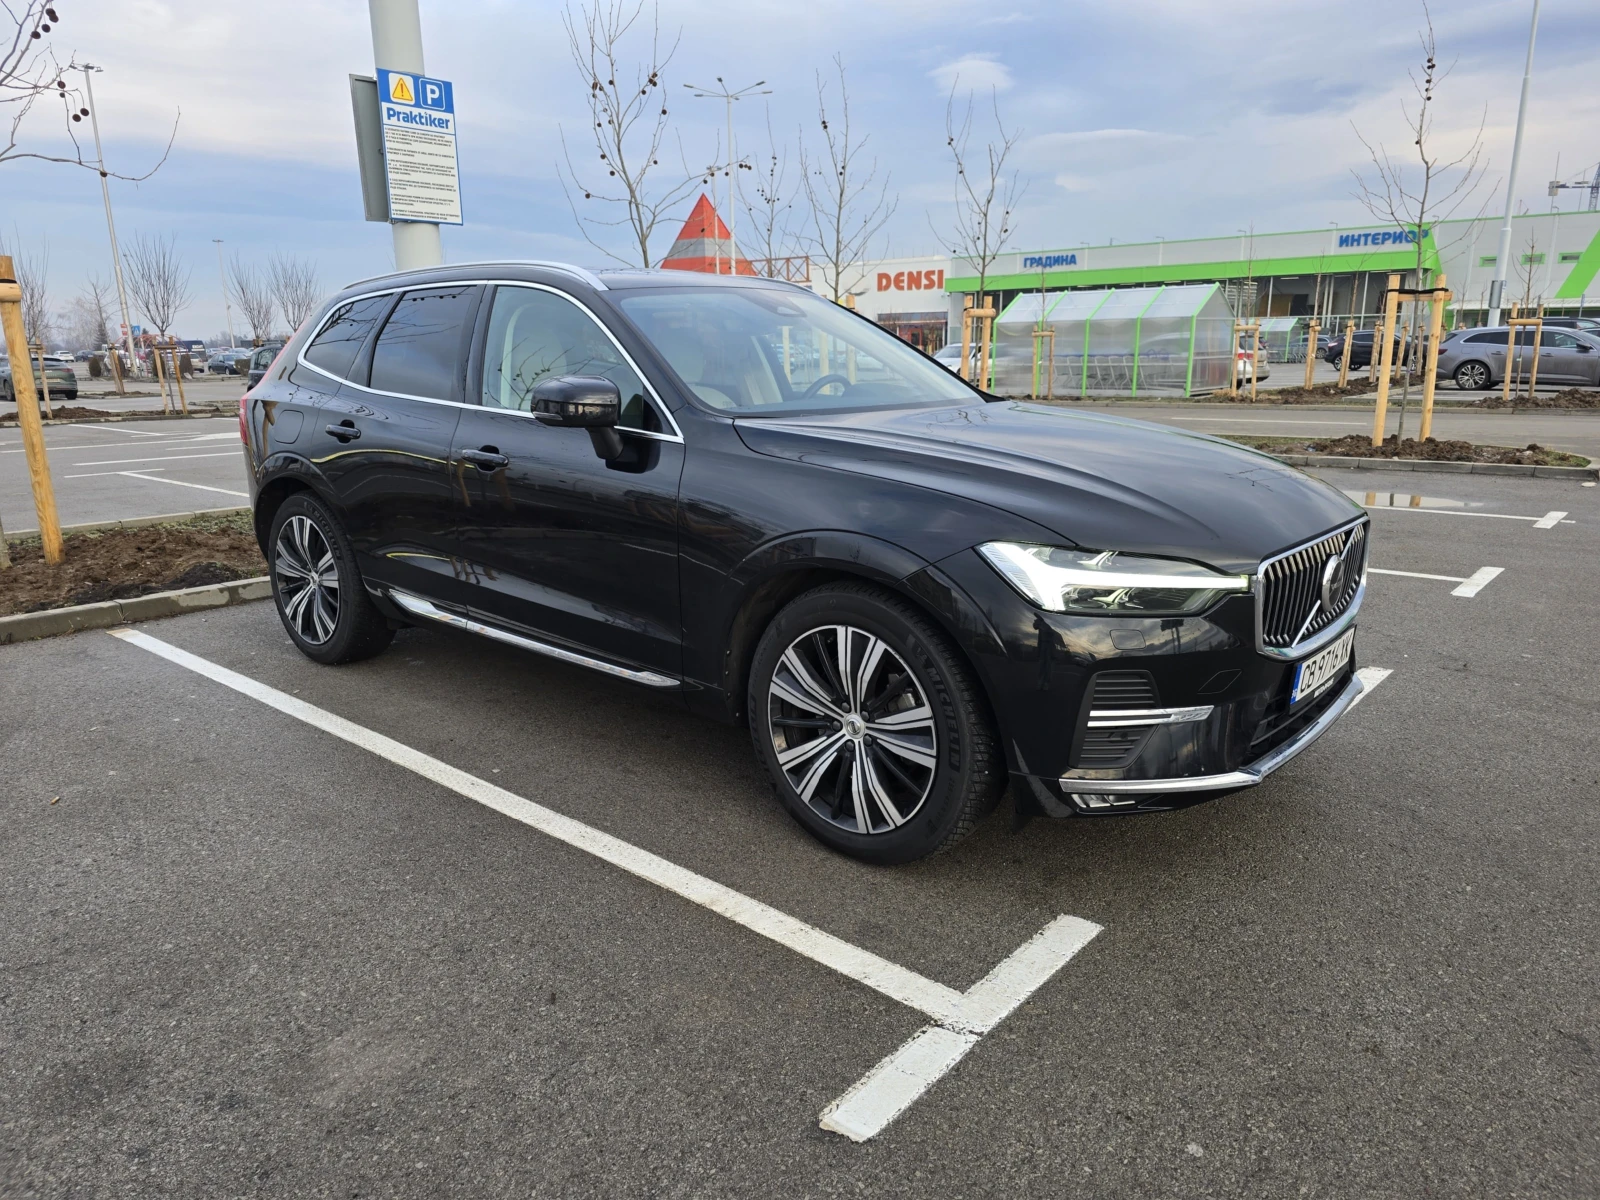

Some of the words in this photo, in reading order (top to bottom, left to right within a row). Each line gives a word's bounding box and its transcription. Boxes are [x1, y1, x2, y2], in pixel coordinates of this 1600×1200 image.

[426, 84, 440, 105] P
[386, 107, 450, 129] Praktiker
[1024, 254, 1077, 269] ГРАДИНА
[877, 269, 944, 292] DENSI
[926, 667, 960, 767] MICHELIN
